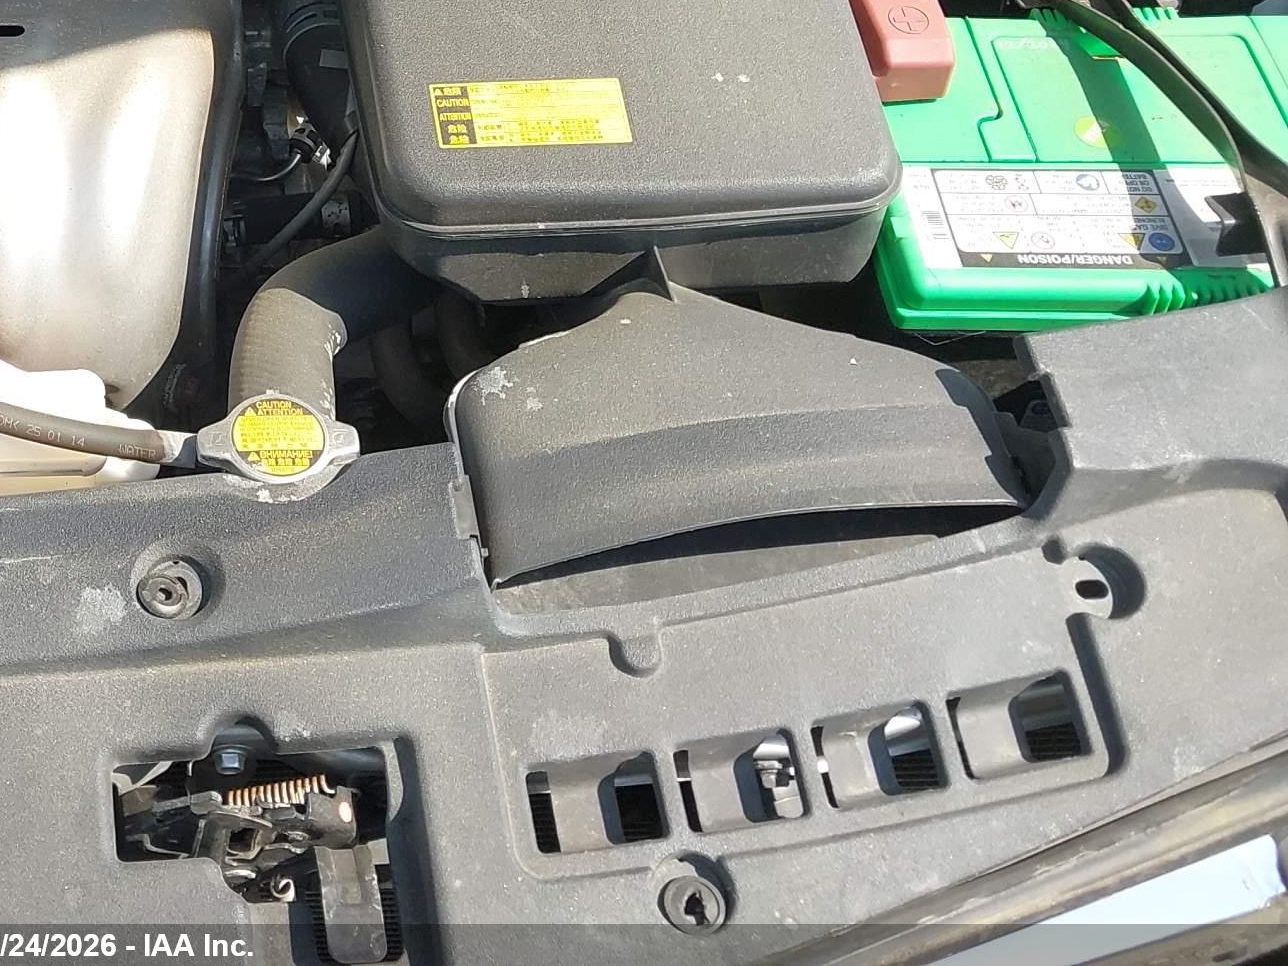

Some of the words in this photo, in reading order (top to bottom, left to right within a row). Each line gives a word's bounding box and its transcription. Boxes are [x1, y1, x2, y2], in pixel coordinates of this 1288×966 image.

[436, 98, 469, 108] CAUTION
[439, 112, 472, 121] ATTENTION
[1017, 252, 1133, 265] DANGER/POISON
[256, 400, 292, 409] CAUTION
[257, 408, 304, 416] ATTENTION
[25, 424, 41, 437] 25
[47, 429, 62, 442] 01
[71, 435, 85, 448] 14
[118, 443, 156, 458] WATER
